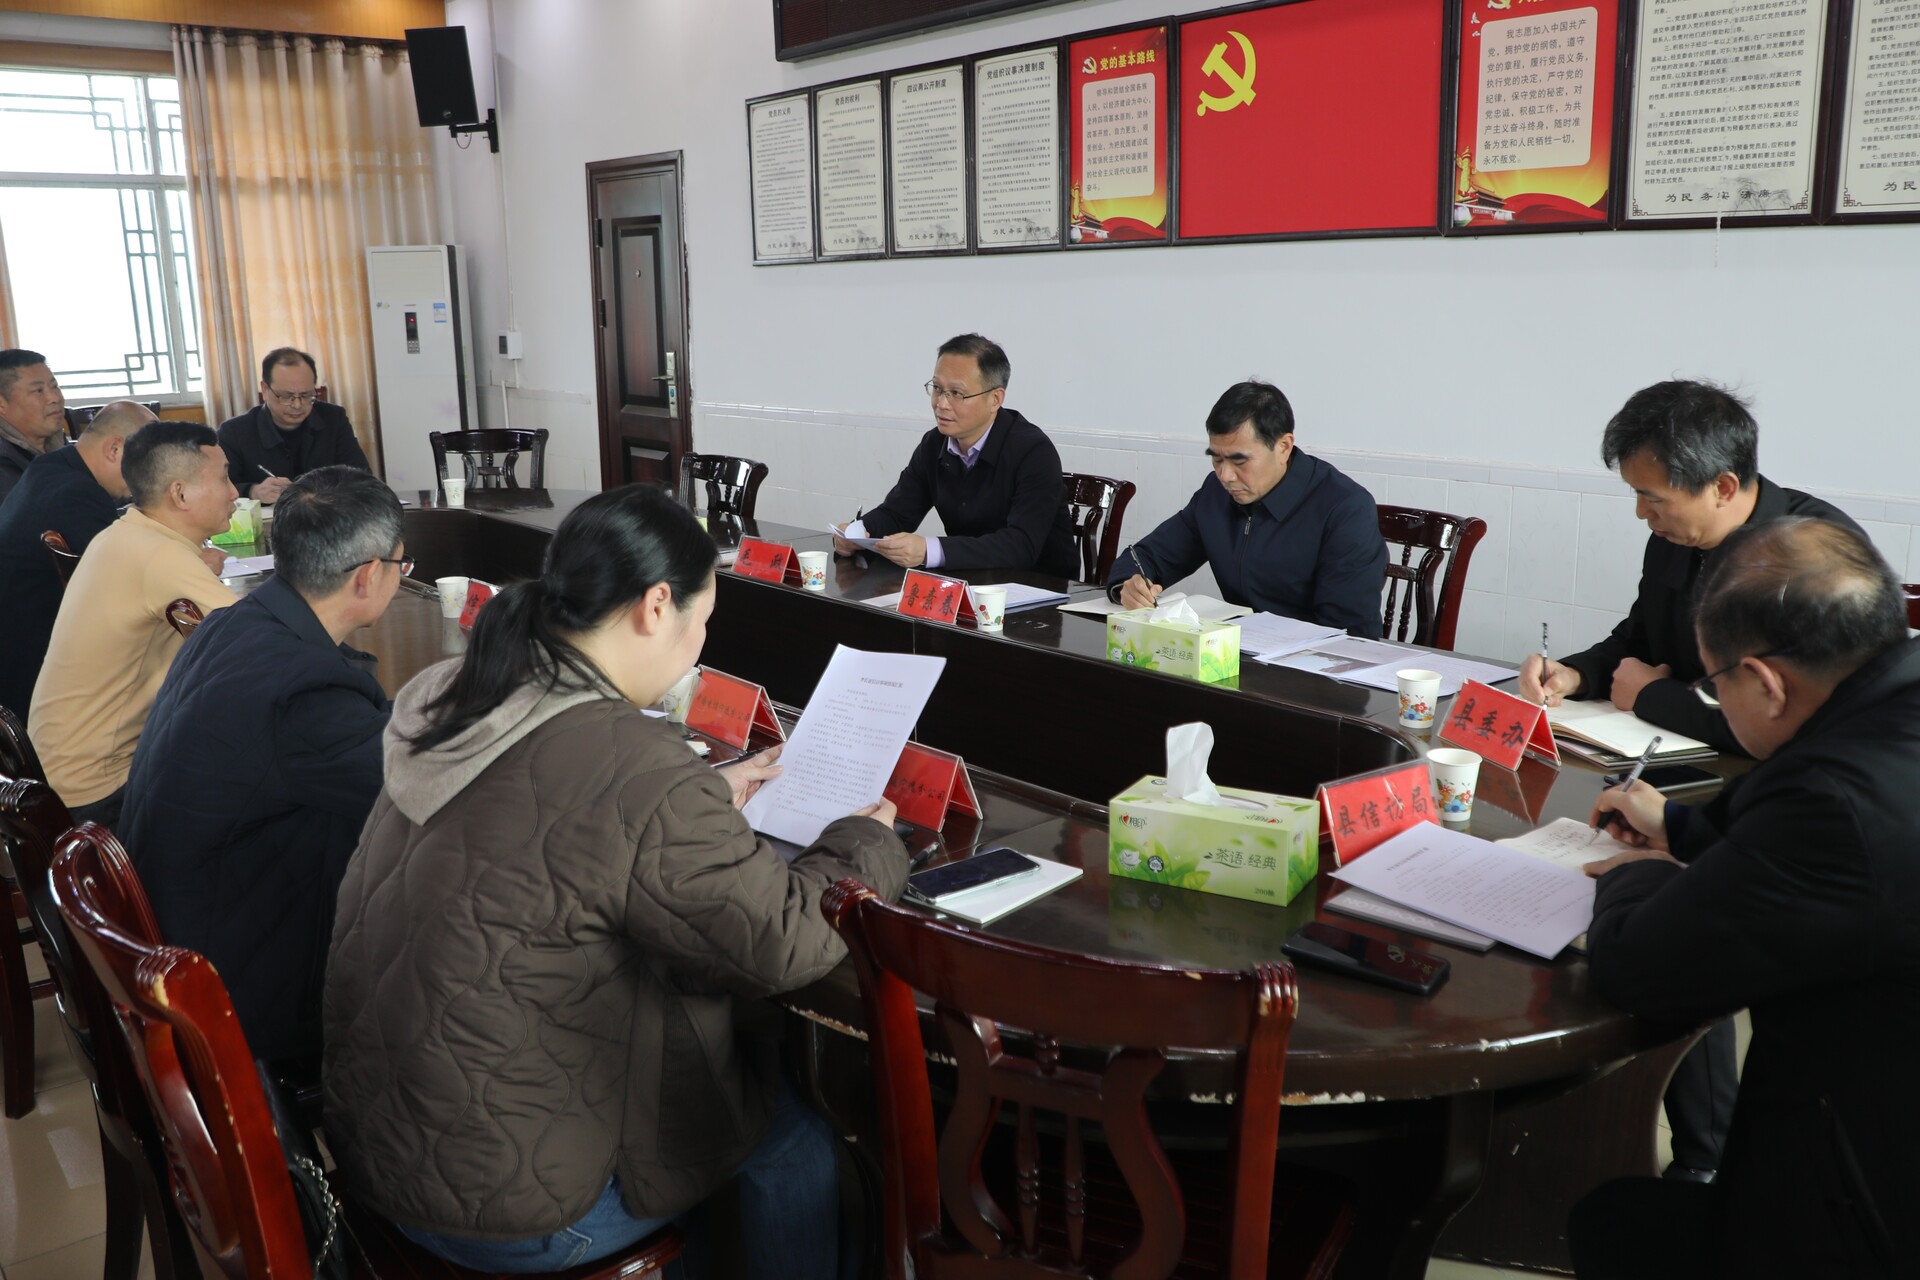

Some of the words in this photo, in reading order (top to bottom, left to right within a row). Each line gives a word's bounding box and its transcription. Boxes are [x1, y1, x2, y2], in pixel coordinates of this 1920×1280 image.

[1506, 18, 1587, 39] 我志愿加入中国共产
[987, 61, 1045, 80] 党组织议事决策制度
[1100, 49, 1155, 71] 党的基本路线
[907, 79, 947, 93] 四议两公开制度
[1883, 181, 1918, 191] 为民
[1665, 193, 1693, 202] 为民
[905, 582, 955, 617] 鲁素春
[1453, 697, 1525, 748] 县委办
[1337, 785, 1429, 838] 县信访局
